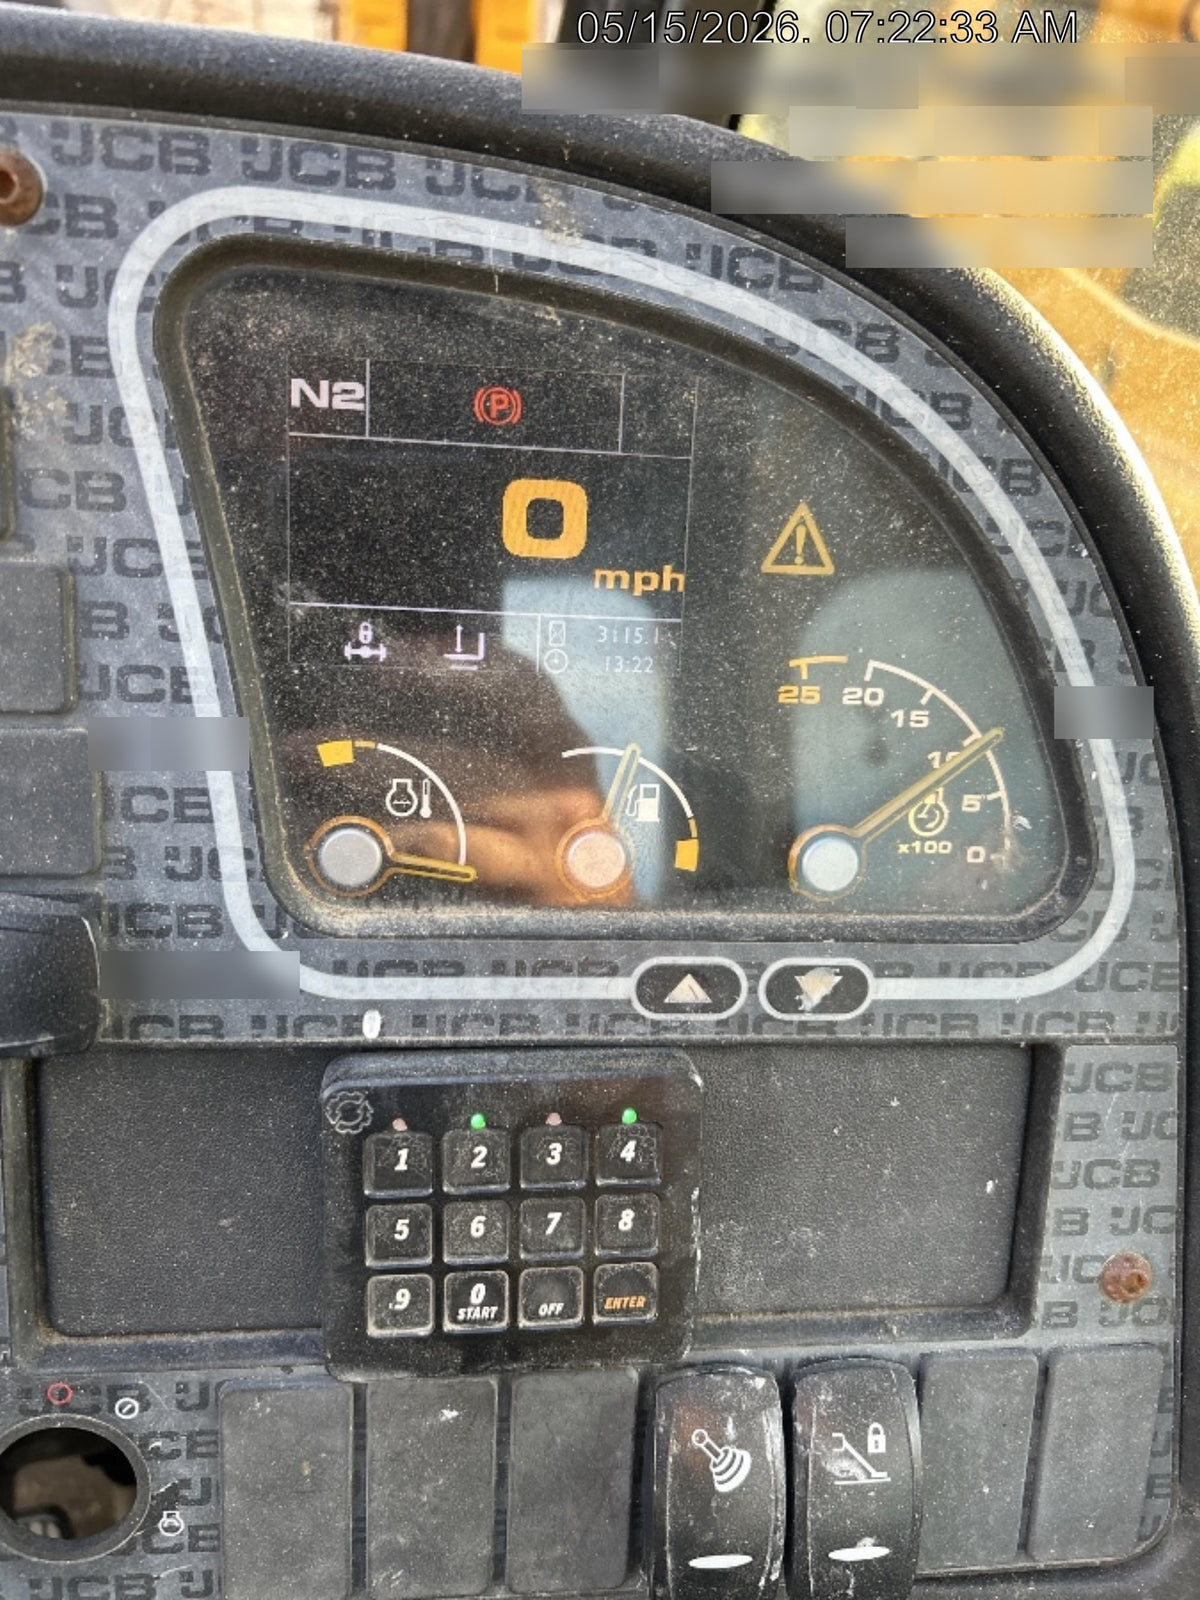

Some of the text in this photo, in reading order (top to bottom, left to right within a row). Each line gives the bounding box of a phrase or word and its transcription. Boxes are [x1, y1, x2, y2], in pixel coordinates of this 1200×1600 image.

[50, 121, 211, 176] JCB
[241, 138, 397, 191] JCB
[290, 377, 365, 410] N2
[592, 565, 686, 597] mph
[604, 655, 654, 674] 13:22
[778, 686, 885, 707] 25 20
[891, 709, 930, 728] 15
[961, 794, 981, 813] 5
[898, 841, 952, 854] x100
[967, 846, 985, 864] 0
[1066, 1062, 1172, 1093] JCB
[394, 1149, 409, 1170] 1
[471, 1146, 488, 1168] 2
[546, 1143, 563, 1165] 3
[620, 1140, 636, 1162] 4
[1051, 1159, 1160, 1189] JCB
[394, 1219, 410, 1240] 5
[470, 1216, 486, 1238] 6
[545, 1212, 562, 1235] 7
[618, 1209, 634, 1231] 8
[397, 1288, 411, 1311] 9
[470, 1284, 486, 1305] 0
[604, 1296, 647, 1310] ENTER
[457, 1306, 499, 1321] START
[538, 1303, 565, 1317] OFF
